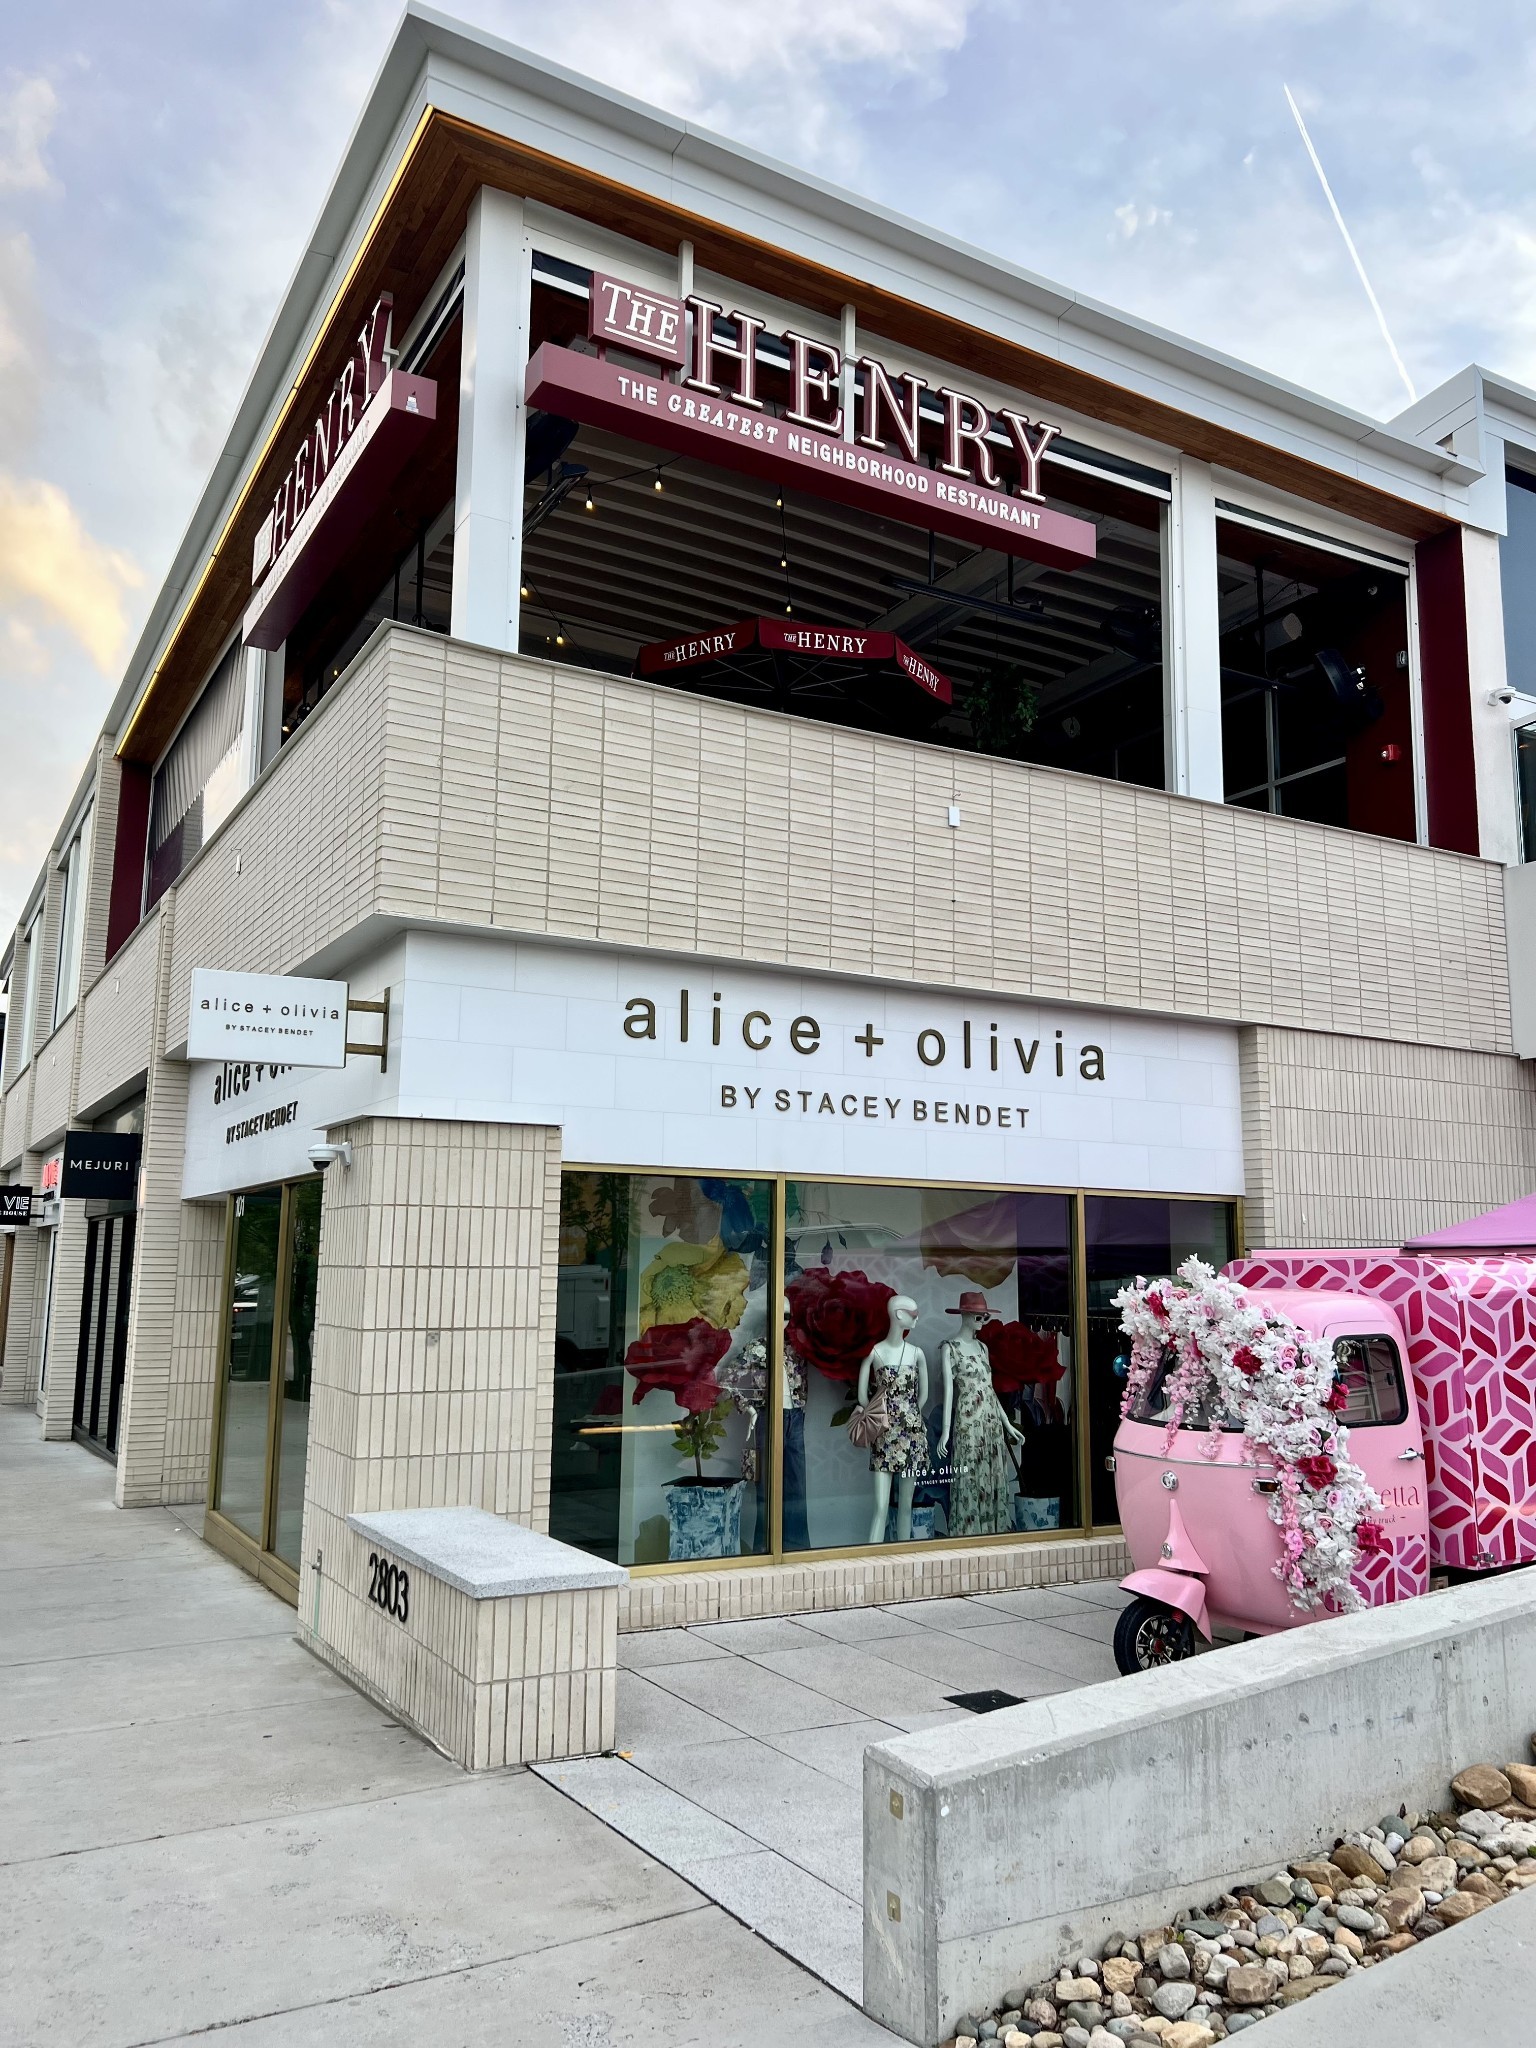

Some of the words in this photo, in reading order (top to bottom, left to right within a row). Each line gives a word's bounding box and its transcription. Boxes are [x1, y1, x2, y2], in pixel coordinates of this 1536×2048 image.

[600, 279, 681, 345] THE
[683, 293, 1062, 503] HENRY
[269, 298, 382, 567] HENRY
[618, 376, 658, 407] THE
[667, 394, 779, 444] GREATEST
[787, 432, 930, 495] NEIGHBORHOOD
[936, 482, 1041, 531] RESTAURANT
[675, 632, 736, 662] HENRY
[784, 632, 797, 643] THE
[797, 631, 868, 654] HENRY
[908, 656, 940, 692] HENRY
[200, 997, 254, 1013] alice
[263, 1004, 272, 1014] +
[280, 1004, 339, 1020] olivia
[239, 1025, 275, 1034] STACEY
[278, 1027, 314, 1036] BENDET
[623, 988, 821, 1054] alice
[854, 1022, 884, 1057] +
[917, 1020, 1106, 1081] olivia
[213, 1062, 251, 1105] alice
[226, 1125, 236, 1144] BY
[235, 1113, 264, 1141] STACEY
[264, 1100, 298, 1131] BENDET
[721, 1084, 762, 1108] BY
[774, 1088, 901, 1119] STACEY
[913, 1099, 1030, 1129] BENDET
[70, 1159, 129, 1171] MEJURI
[3, 1195, 30, 1210] VIE
[901, 1467, 927, 1478] alice
[939, 1465, 969, 1475] olivia
[367, 1552, 409, 1623] 2803
